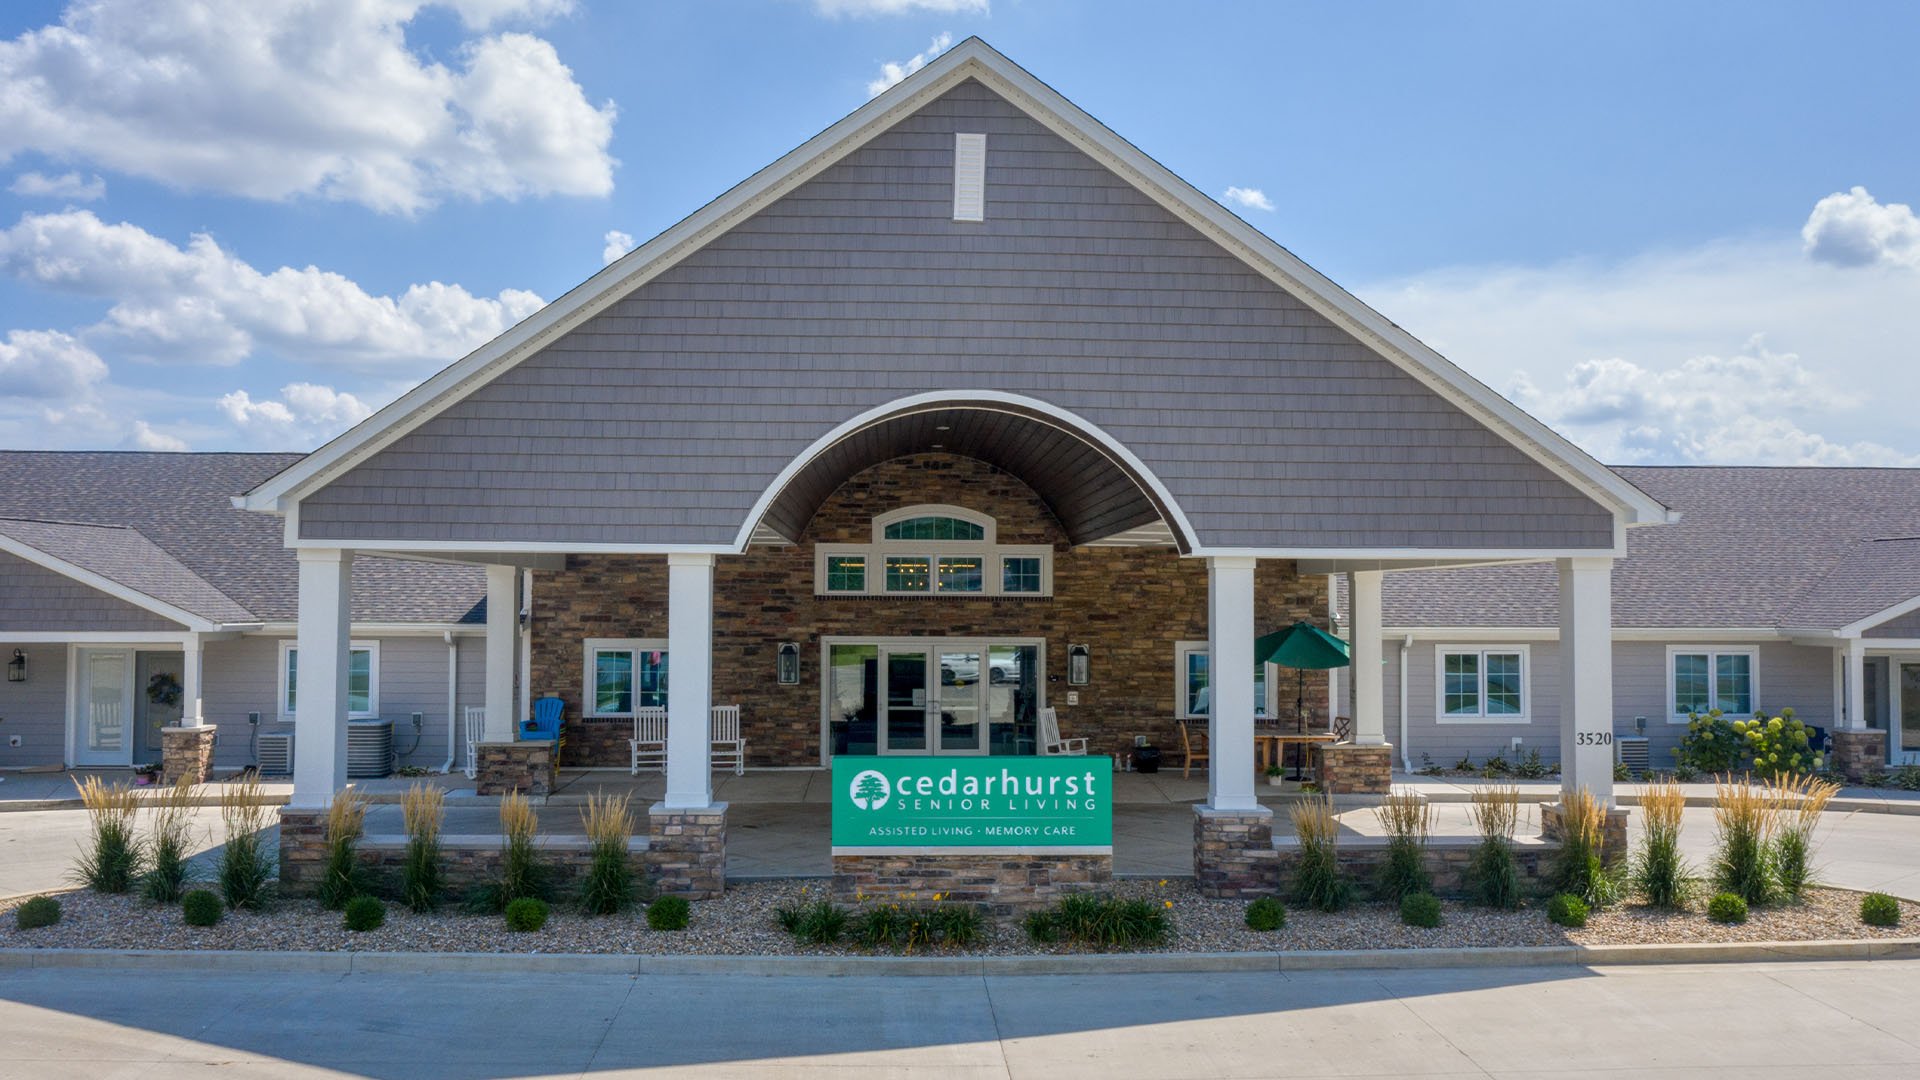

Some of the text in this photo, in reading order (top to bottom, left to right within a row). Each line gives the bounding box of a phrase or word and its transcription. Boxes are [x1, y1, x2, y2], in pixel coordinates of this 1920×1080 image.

[1577, 732, 1612, 745] 3520
[896, 768, 1096, 796] cedarhurst
[898, 799, 1096, 810] SENIOR LIVING
[869, 826, 1076, 836] ASSISTED LIVING MEMORY CARE
